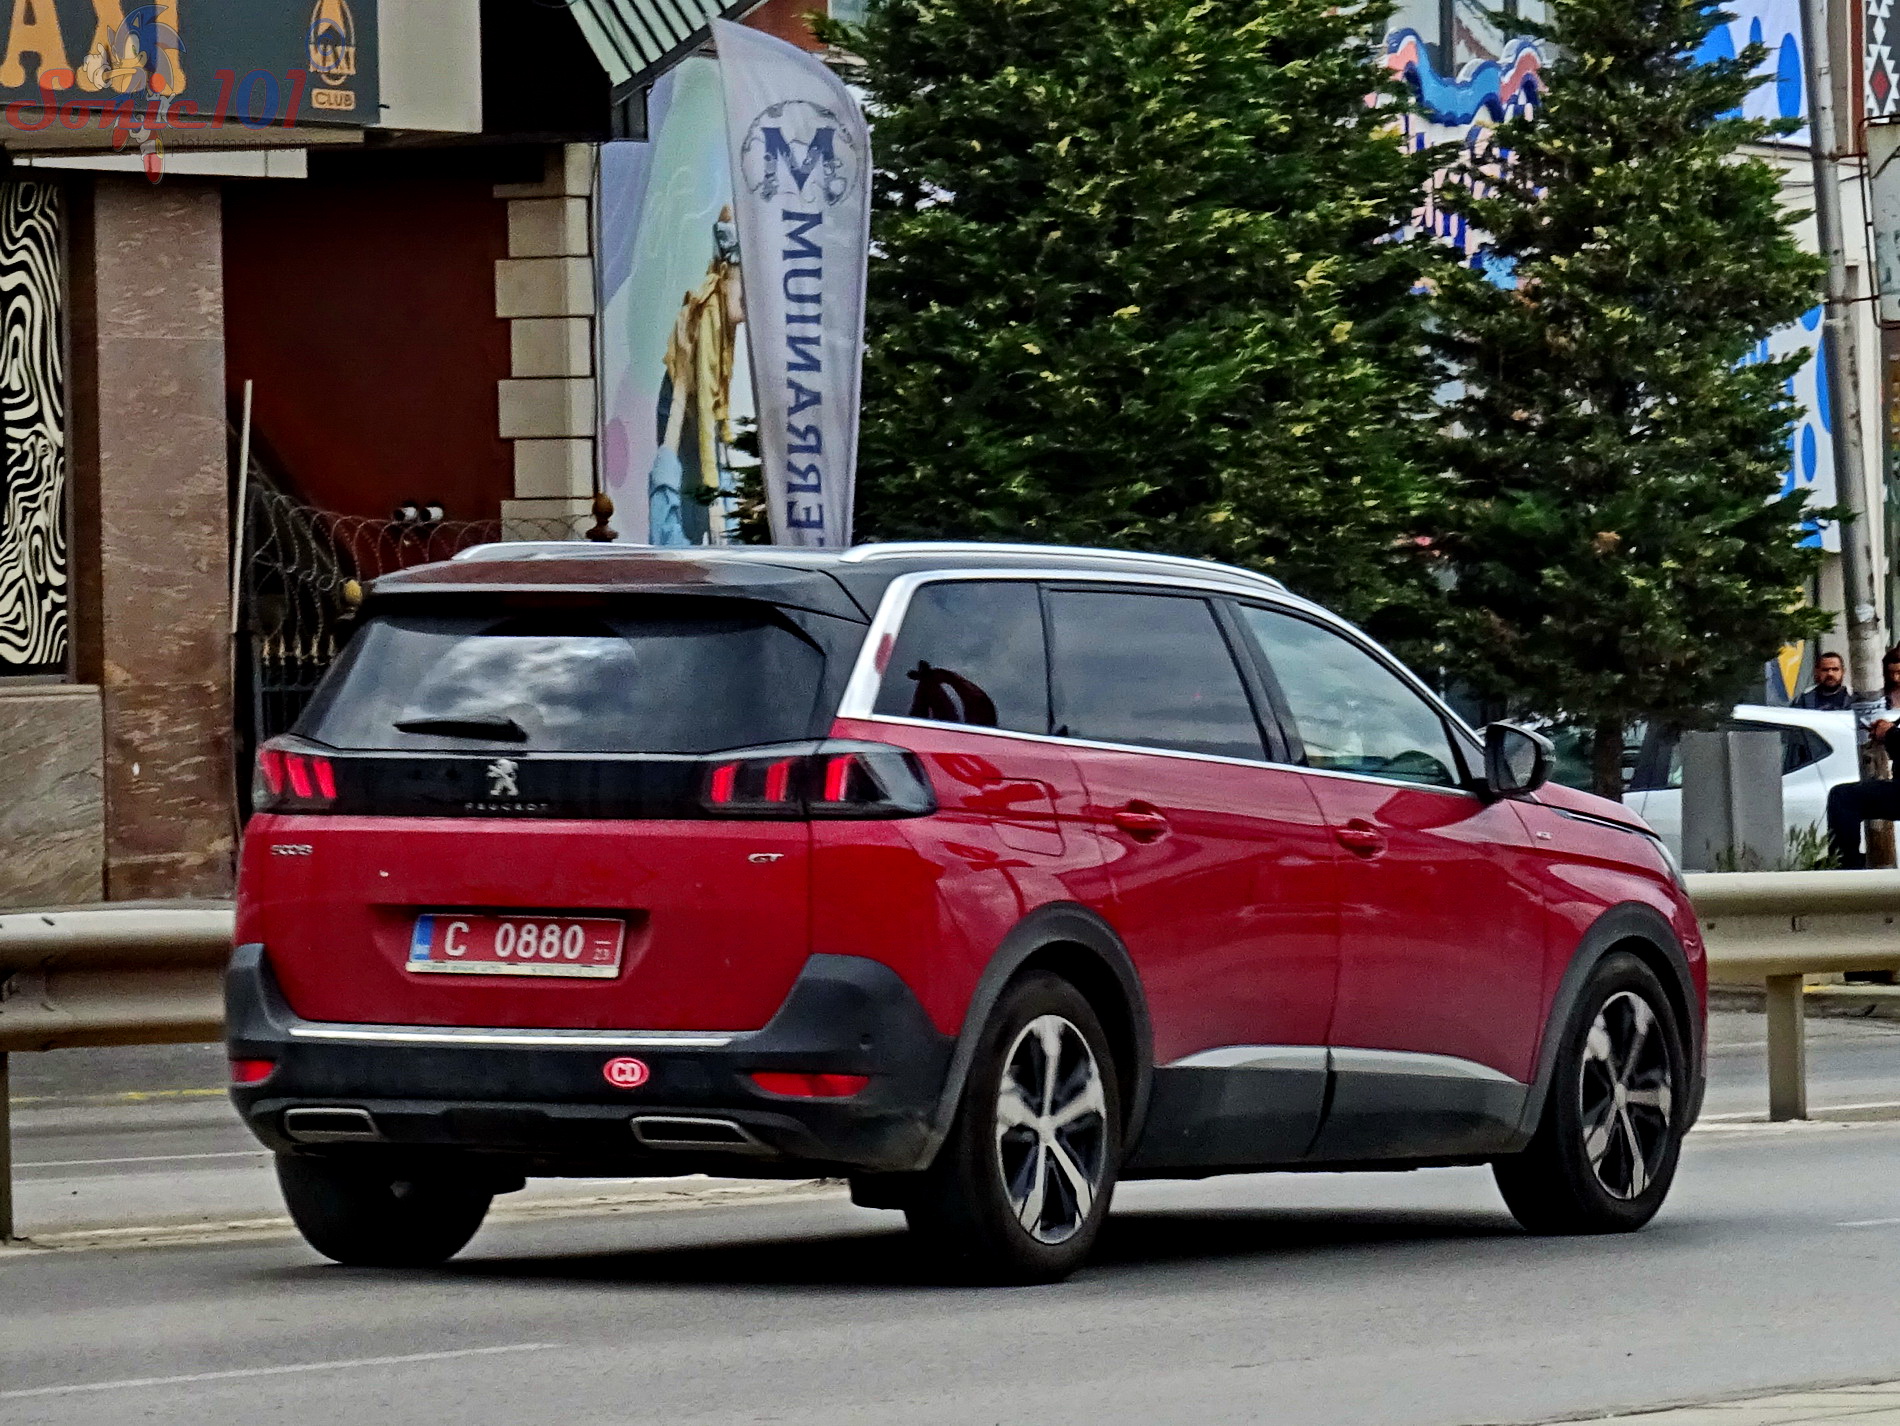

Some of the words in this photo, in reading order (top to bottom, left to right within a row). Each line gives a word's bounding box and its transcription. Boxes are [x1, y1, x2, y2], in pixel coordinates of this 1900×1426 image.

[314, 91, 353, 108] CLUB
[748, 853, 785, 863] GT
[444, 921, 470, 957] C
[494, 922, 585, 960] 0880
[611, 1062, 641, 1082] CD
